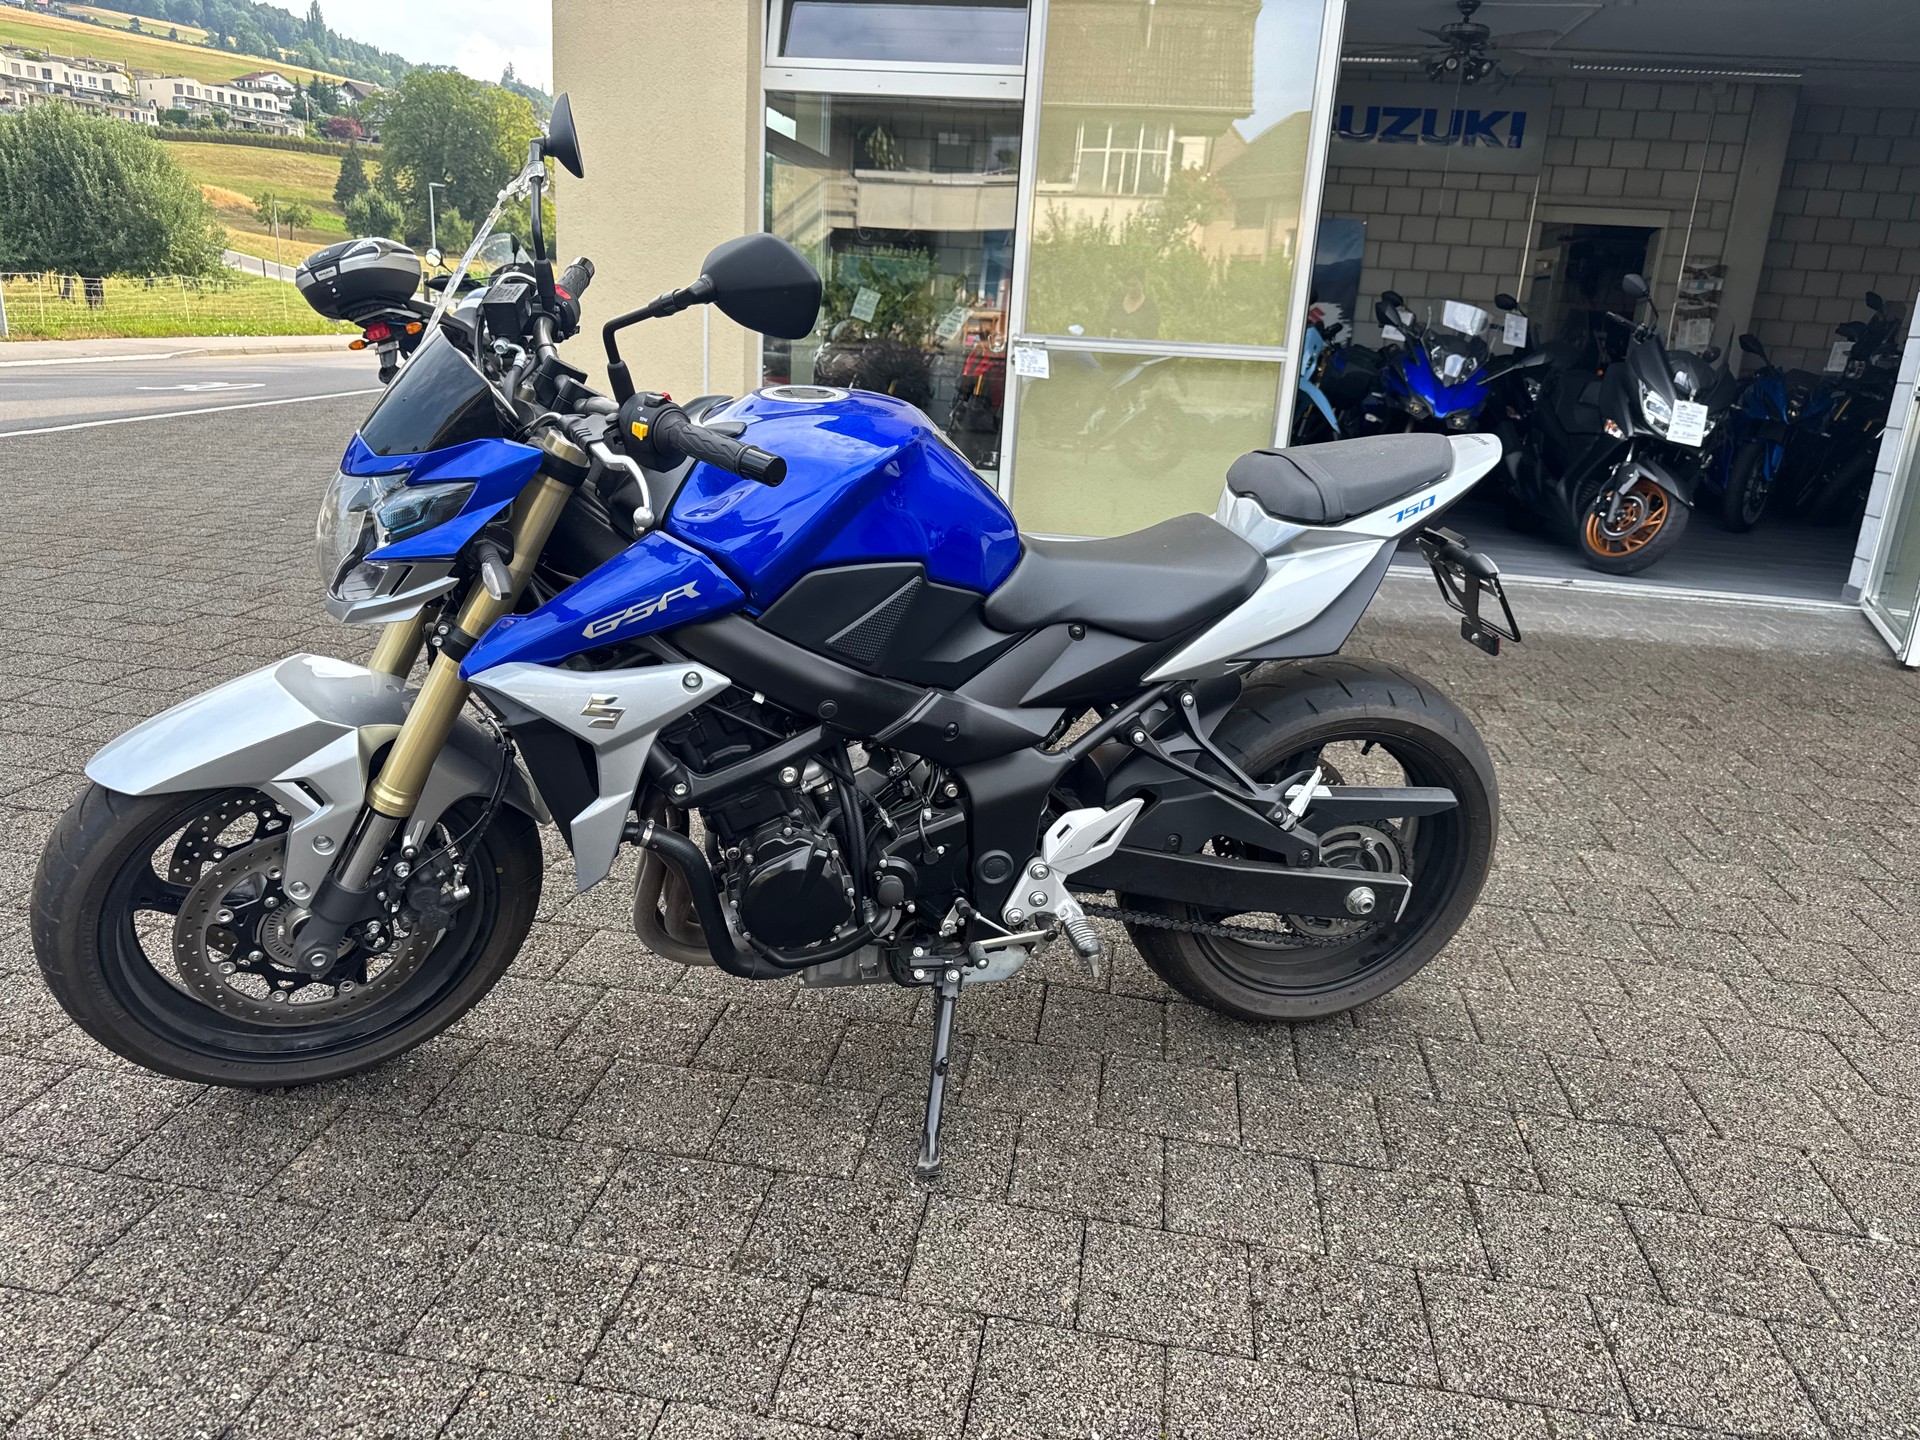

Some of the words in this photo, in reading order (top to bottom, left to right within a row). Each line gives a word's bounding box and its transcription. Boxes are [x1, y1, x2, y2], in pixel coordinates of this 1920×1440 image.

[1332, 105, 1527, 149] UZUKI
[1388, 494, 1436, 523] 750
[581, 580, 701, 639] GSR
